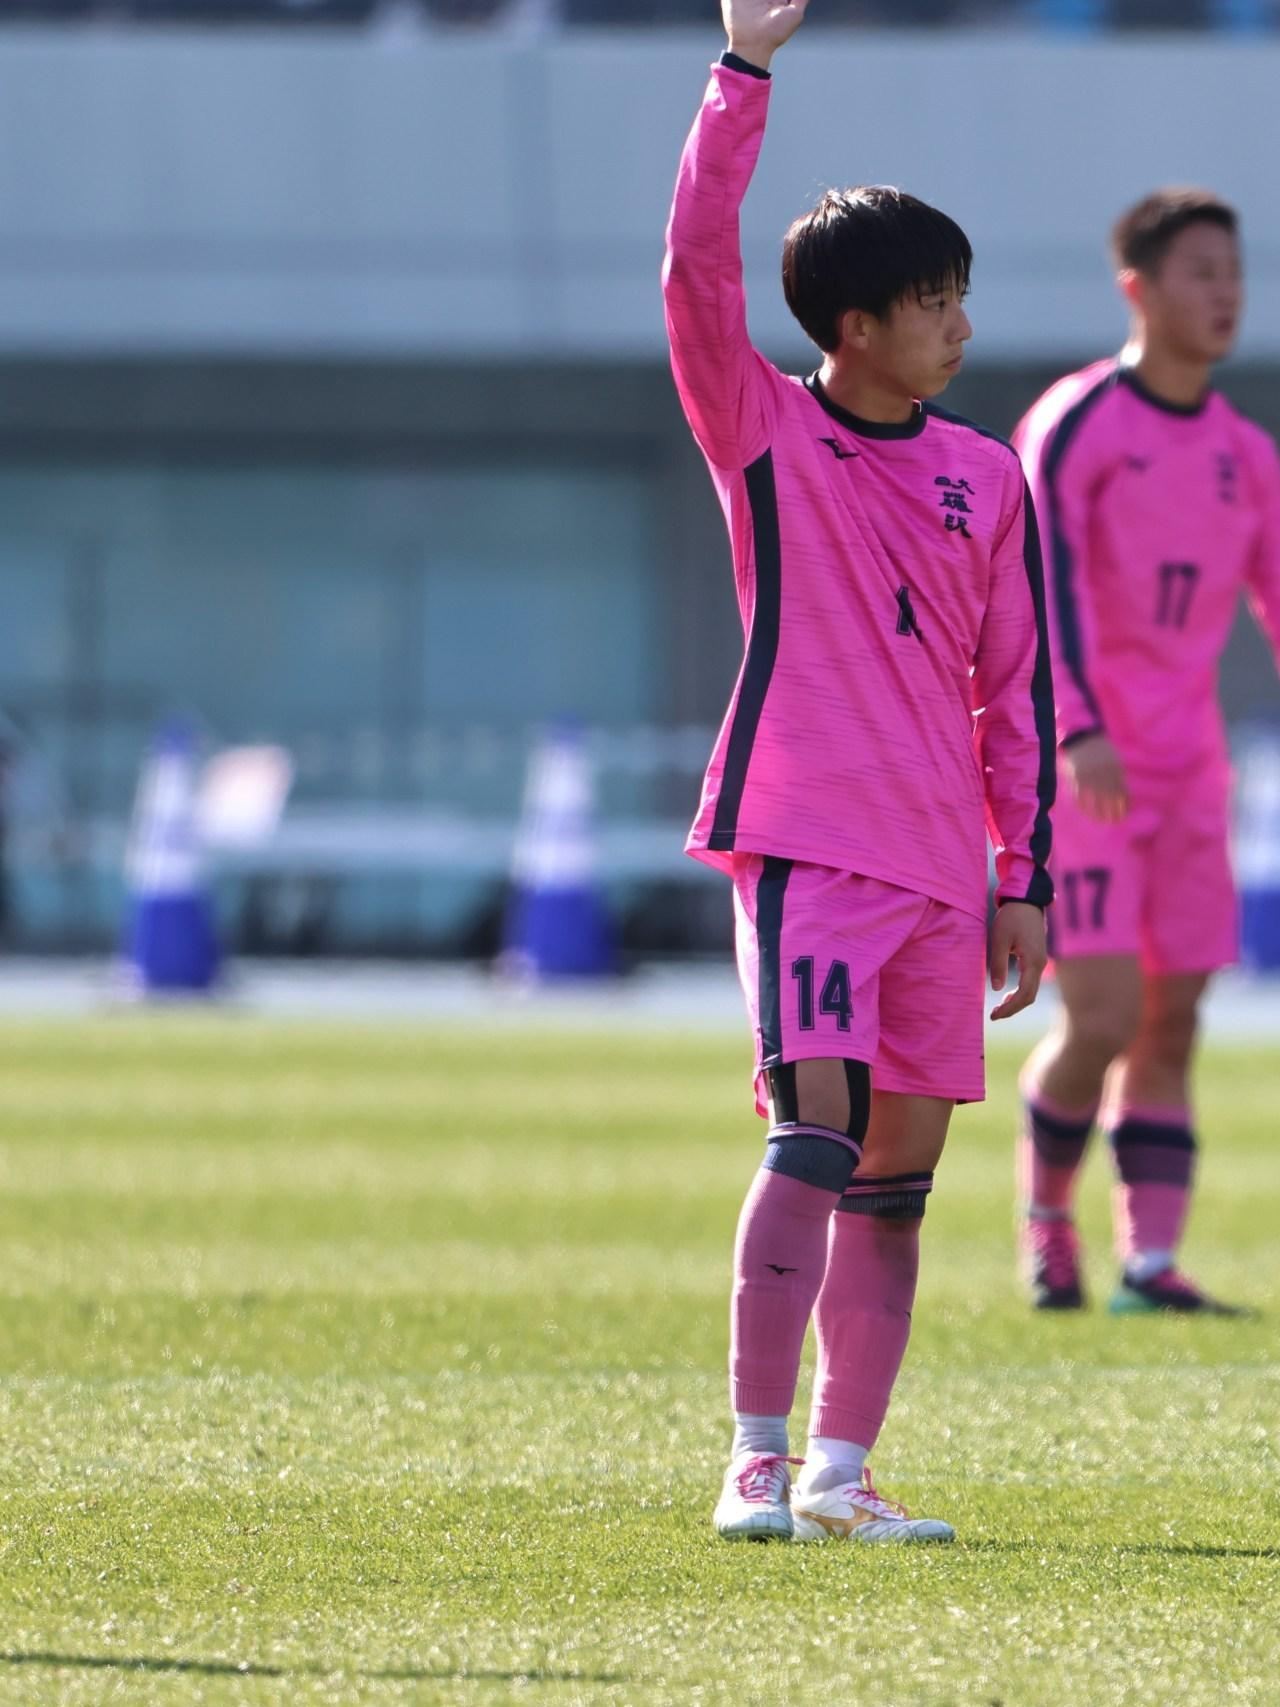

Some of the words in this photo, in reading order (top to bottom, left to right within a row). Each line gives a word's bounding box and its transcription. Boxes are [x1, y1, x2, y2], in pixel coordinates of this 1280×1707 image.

[1155, 562, 1200, 632] 17
[1062, 868, 1113, 932] 17
[792, 955, 854, 1032] 14
